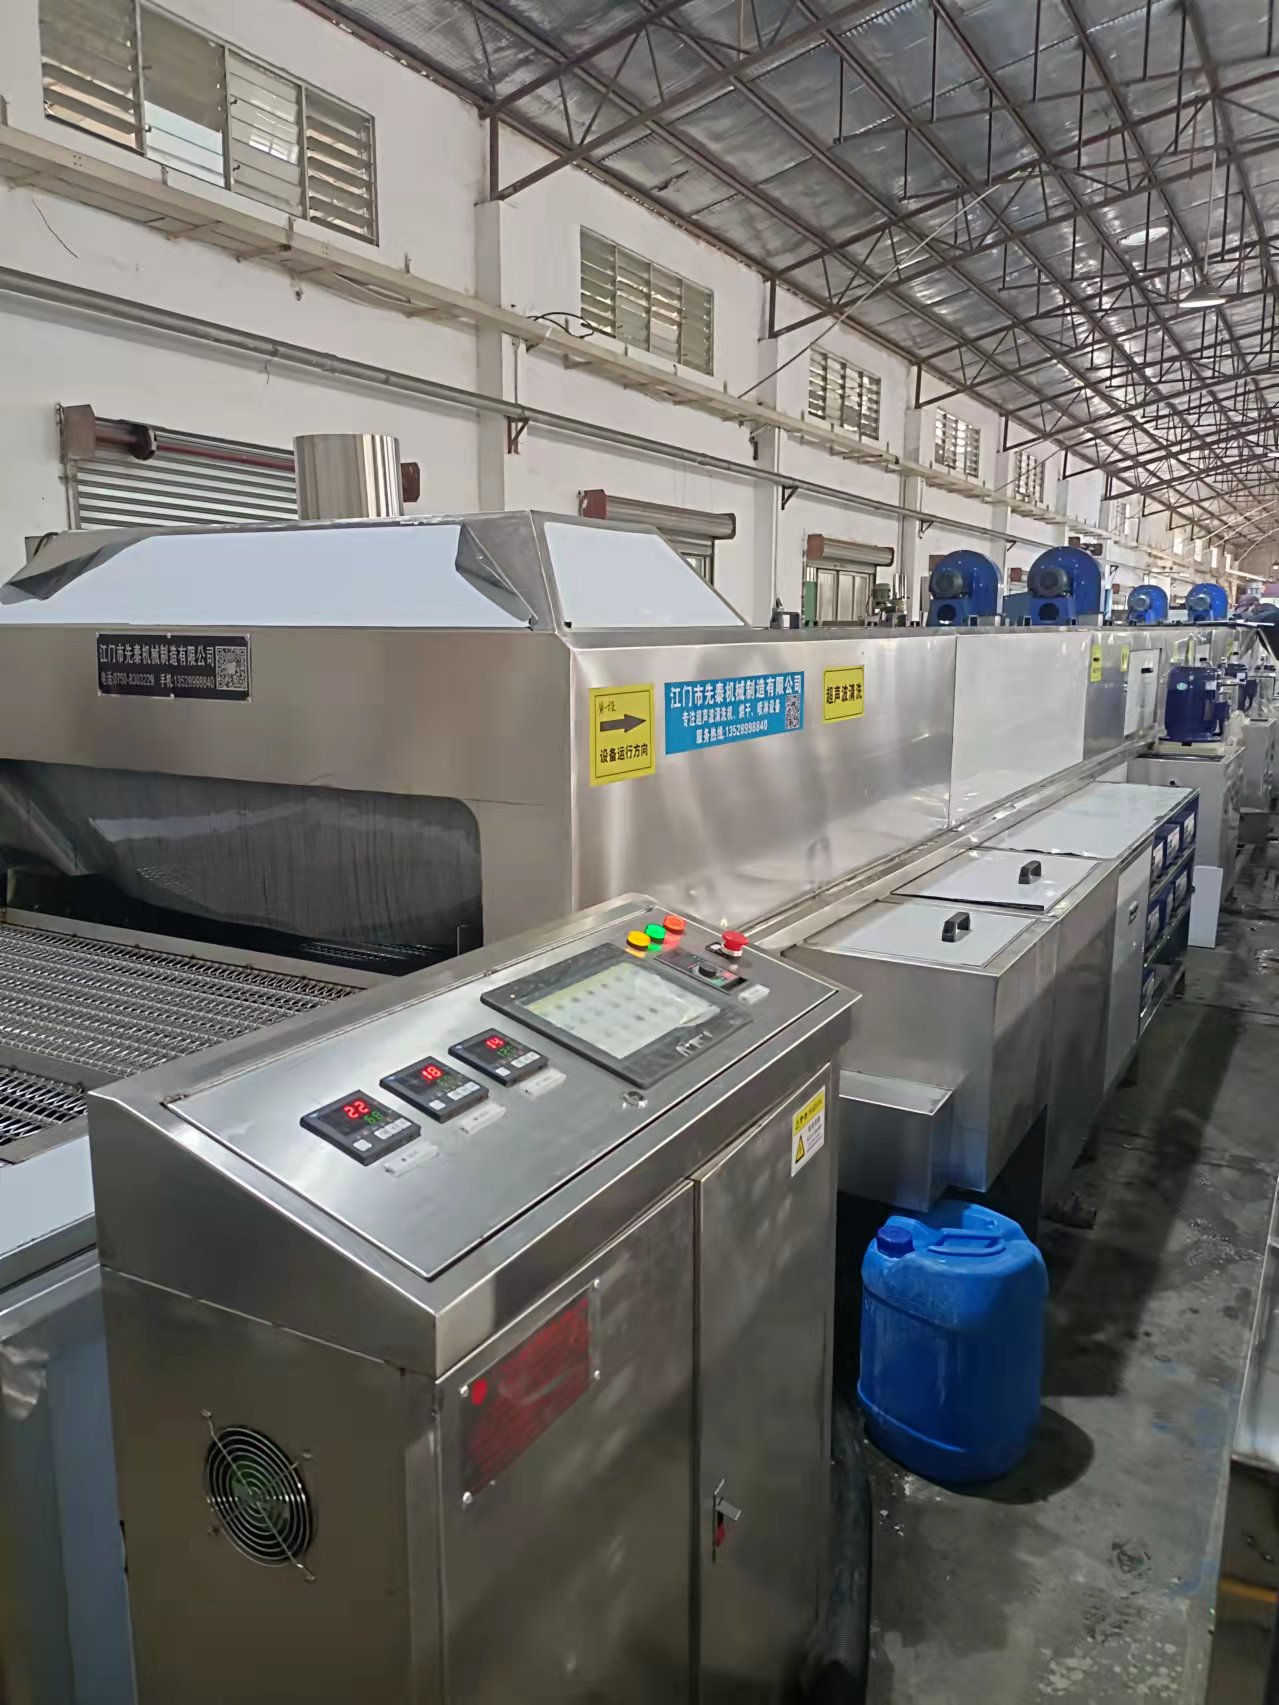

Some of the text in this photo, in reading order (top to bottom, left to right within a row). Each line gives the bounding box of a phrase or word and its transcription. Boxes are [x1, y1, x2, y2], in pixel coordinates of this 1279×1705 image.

[99, 644, 215, 667] 江门市先泰机械制造有限公司
[670, 675, 802, 708] 江门市先泰机械制造有限公司
[826, 682, 863, 705] 超声波清洗
[600, 742, 649, 764] 设备运行方向
[486, 1036, 505, 1050] 14
[422, 1065, 442, 1080] 18
[343, 1100, 369, 1118] 22
[363, 1110, 383, 1125] 68
